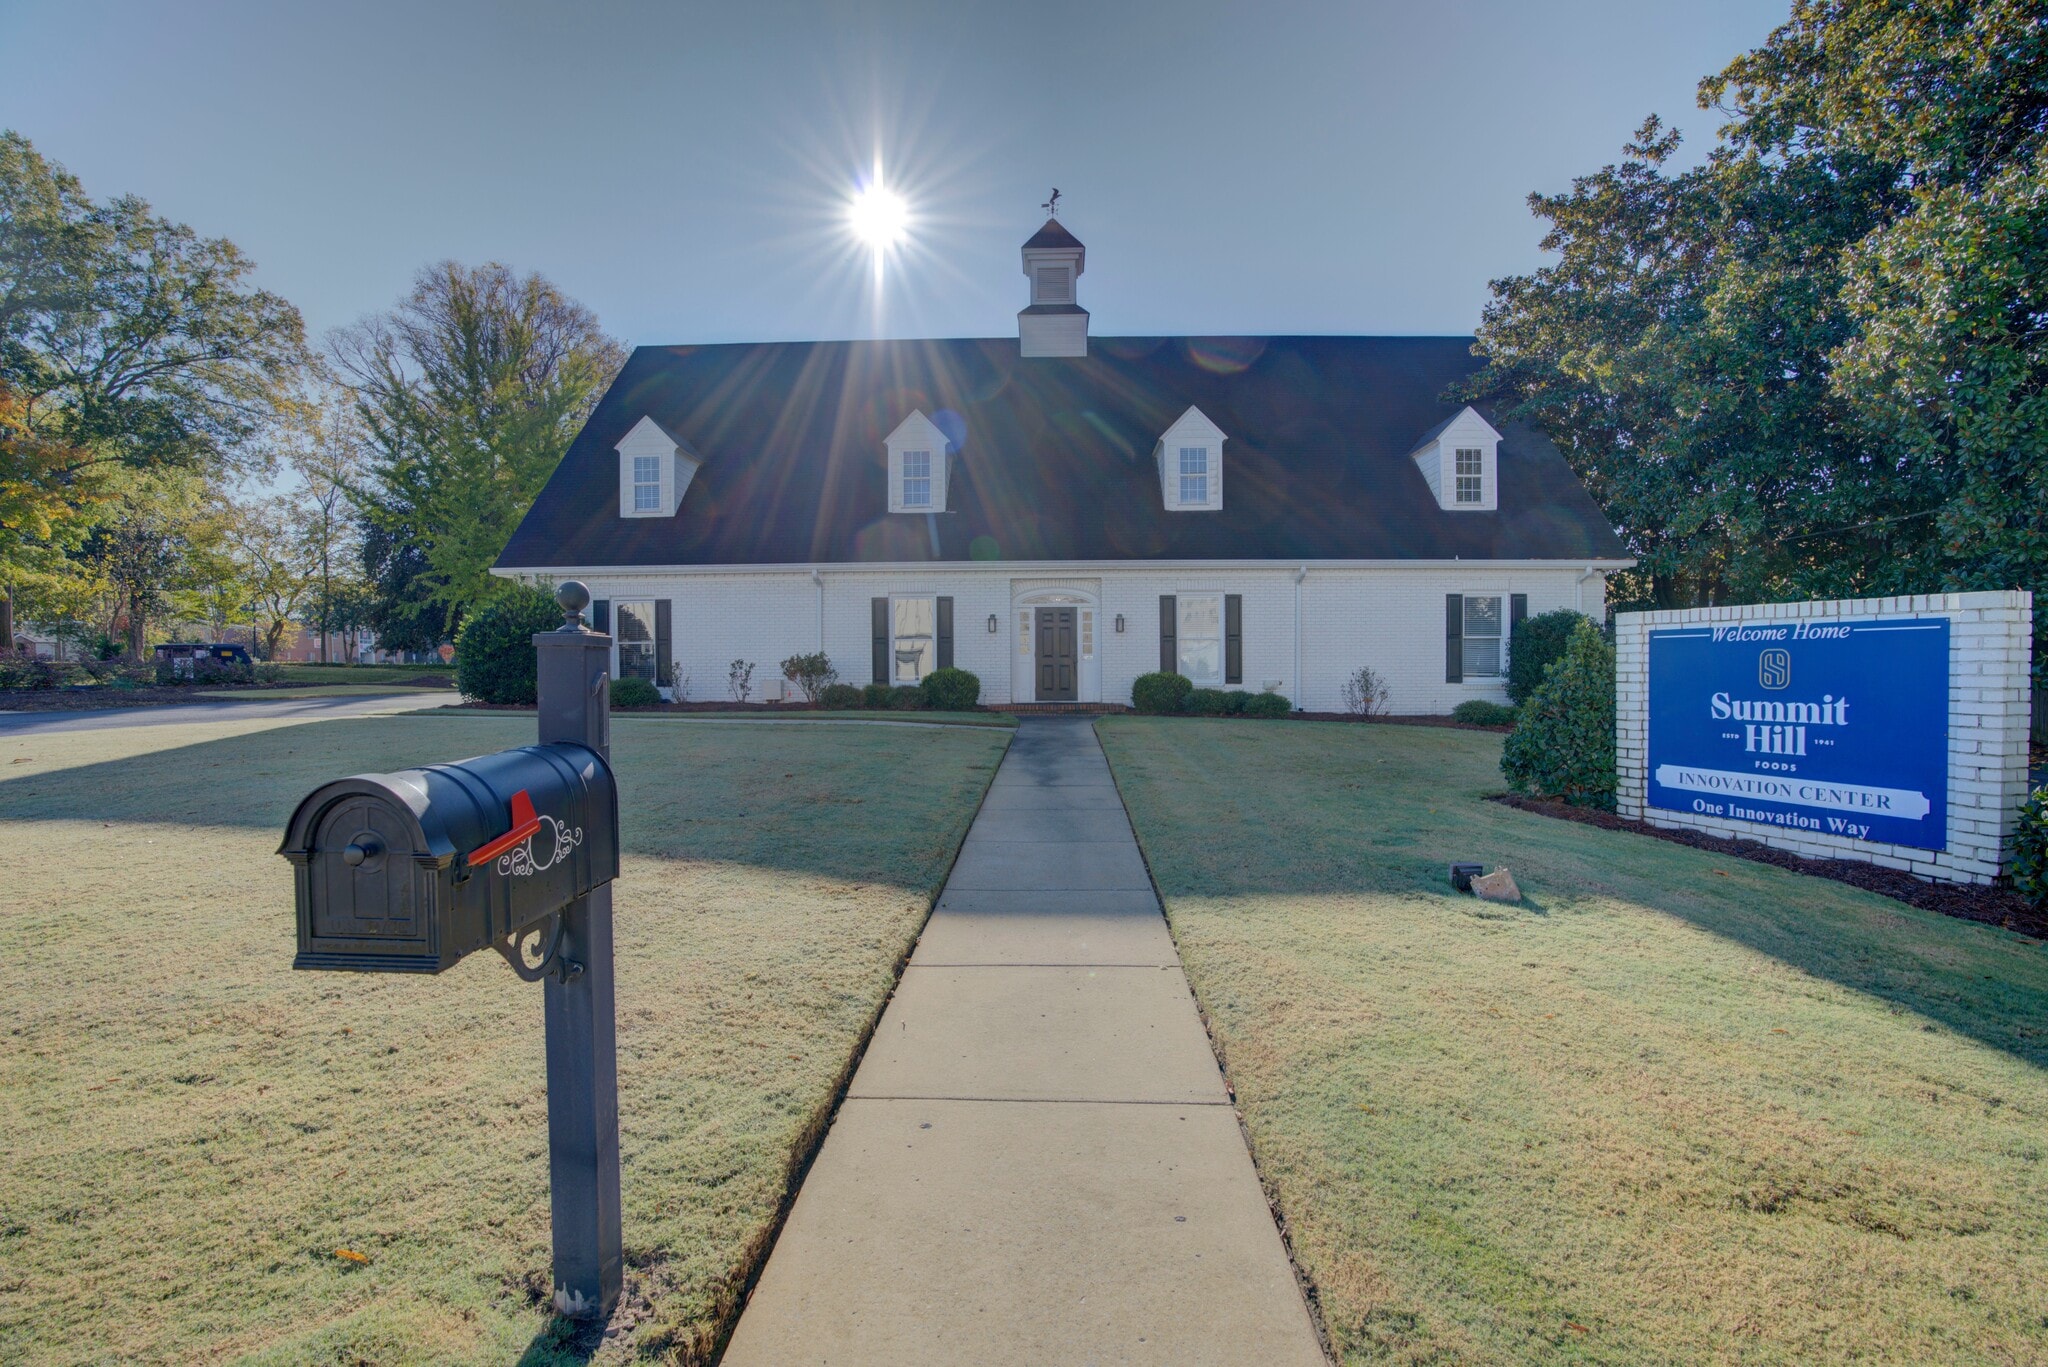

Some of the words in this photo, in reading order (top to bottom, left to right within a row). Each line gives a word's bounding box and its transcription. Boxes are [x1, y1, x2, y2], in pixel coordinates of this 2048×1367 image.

[1712, 626, 1787, 643] Welcome
[1792, 623, 1850, 640] Home
[1711, 692, 1850, 726] Summit
[1745, 724, 1807, 756] Hill
[1755, 760, 1797, 772] FOODS
[1679, 772, 1792, 797] INNOVATION
[1799, 786, 1891, 810] CENTER
[1692, 799, 1724, 815] One
[1729, 803, 1820, 830] Innovation
[1826, 817, 1870, 840] Way
